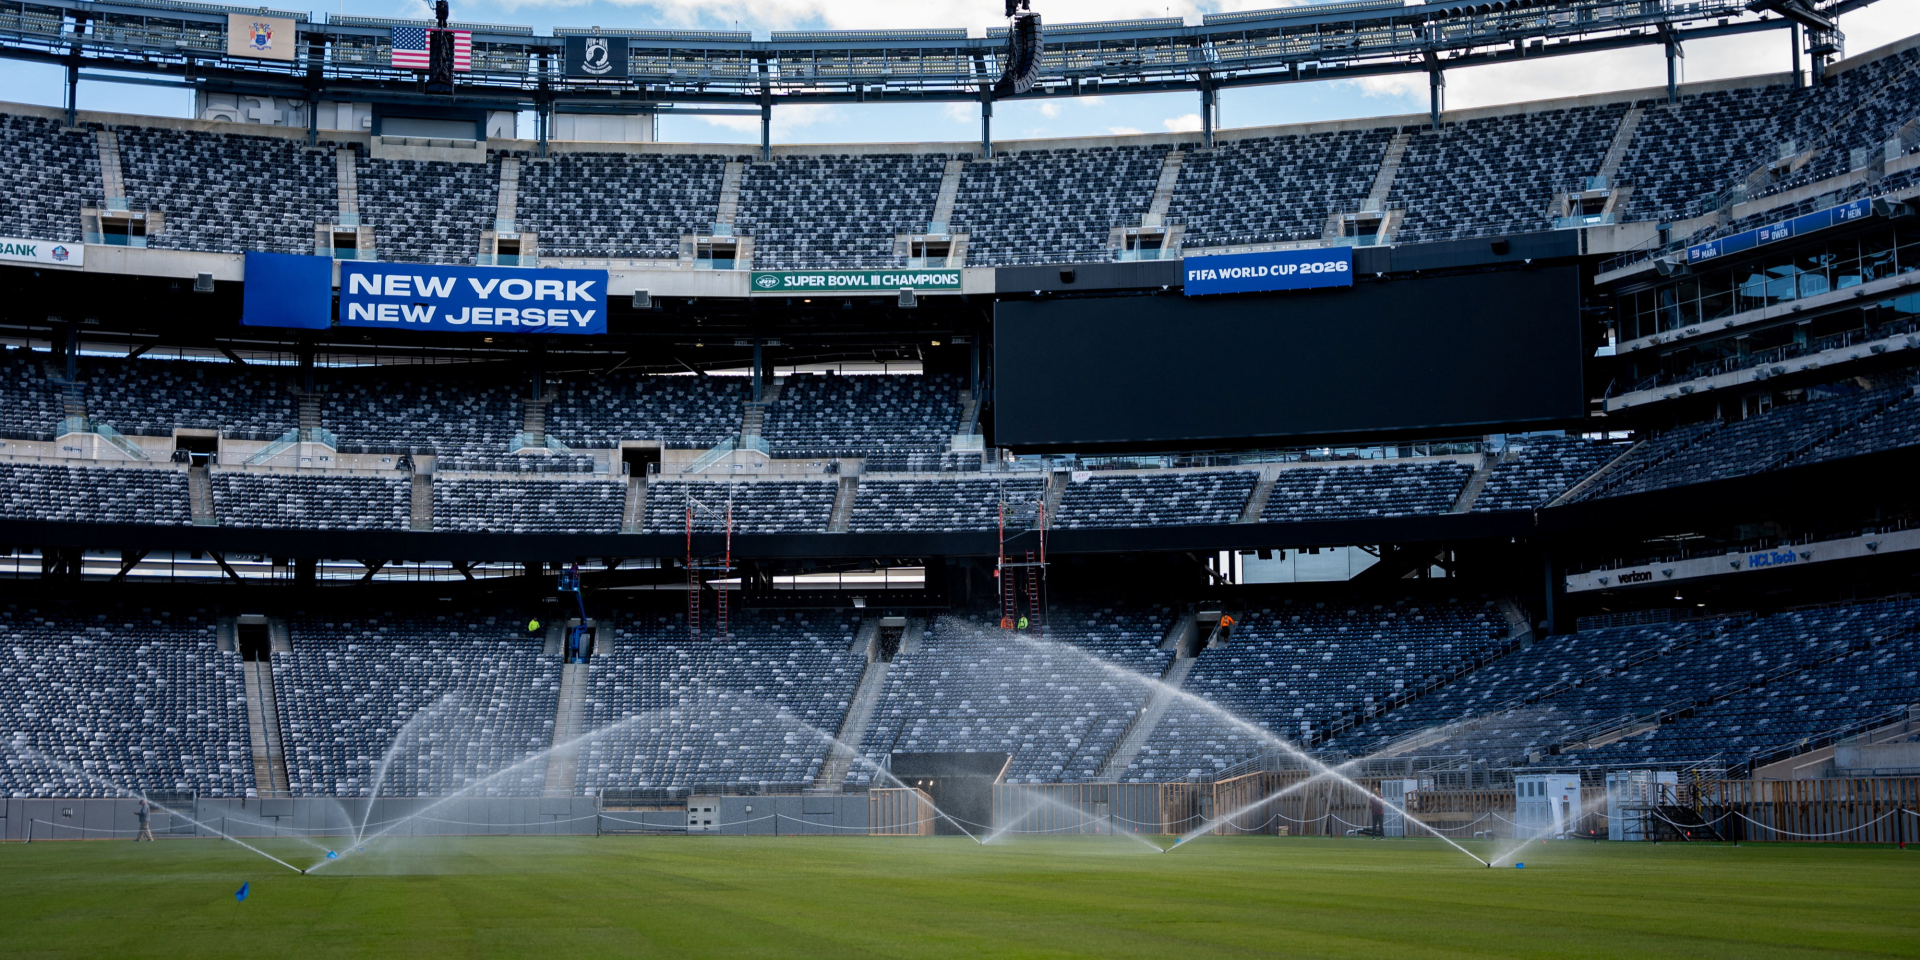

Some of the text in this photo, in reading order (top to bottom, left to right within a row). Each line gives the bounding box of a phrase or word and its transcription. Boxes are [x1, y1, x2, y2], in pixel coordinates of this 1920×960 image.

[1840, 207, 1862, 220] 7 HEIN
[1771, 228, 1788, 240] OWEN
[1701, 247, 1717, 259] MARA
[1188, 261, 1348, 281] FIFA WORLD CUP 2026
[349, 273, 597, 301] NEW YORK
[784, 273, 959, 287] SUPER BOWL III CHAMPIONS
[348, 302, 597, 327] NEW JERSEY
[1749, 549, 1797, 568] HCLTech
[1618, 570, 1652, 584] verizon
